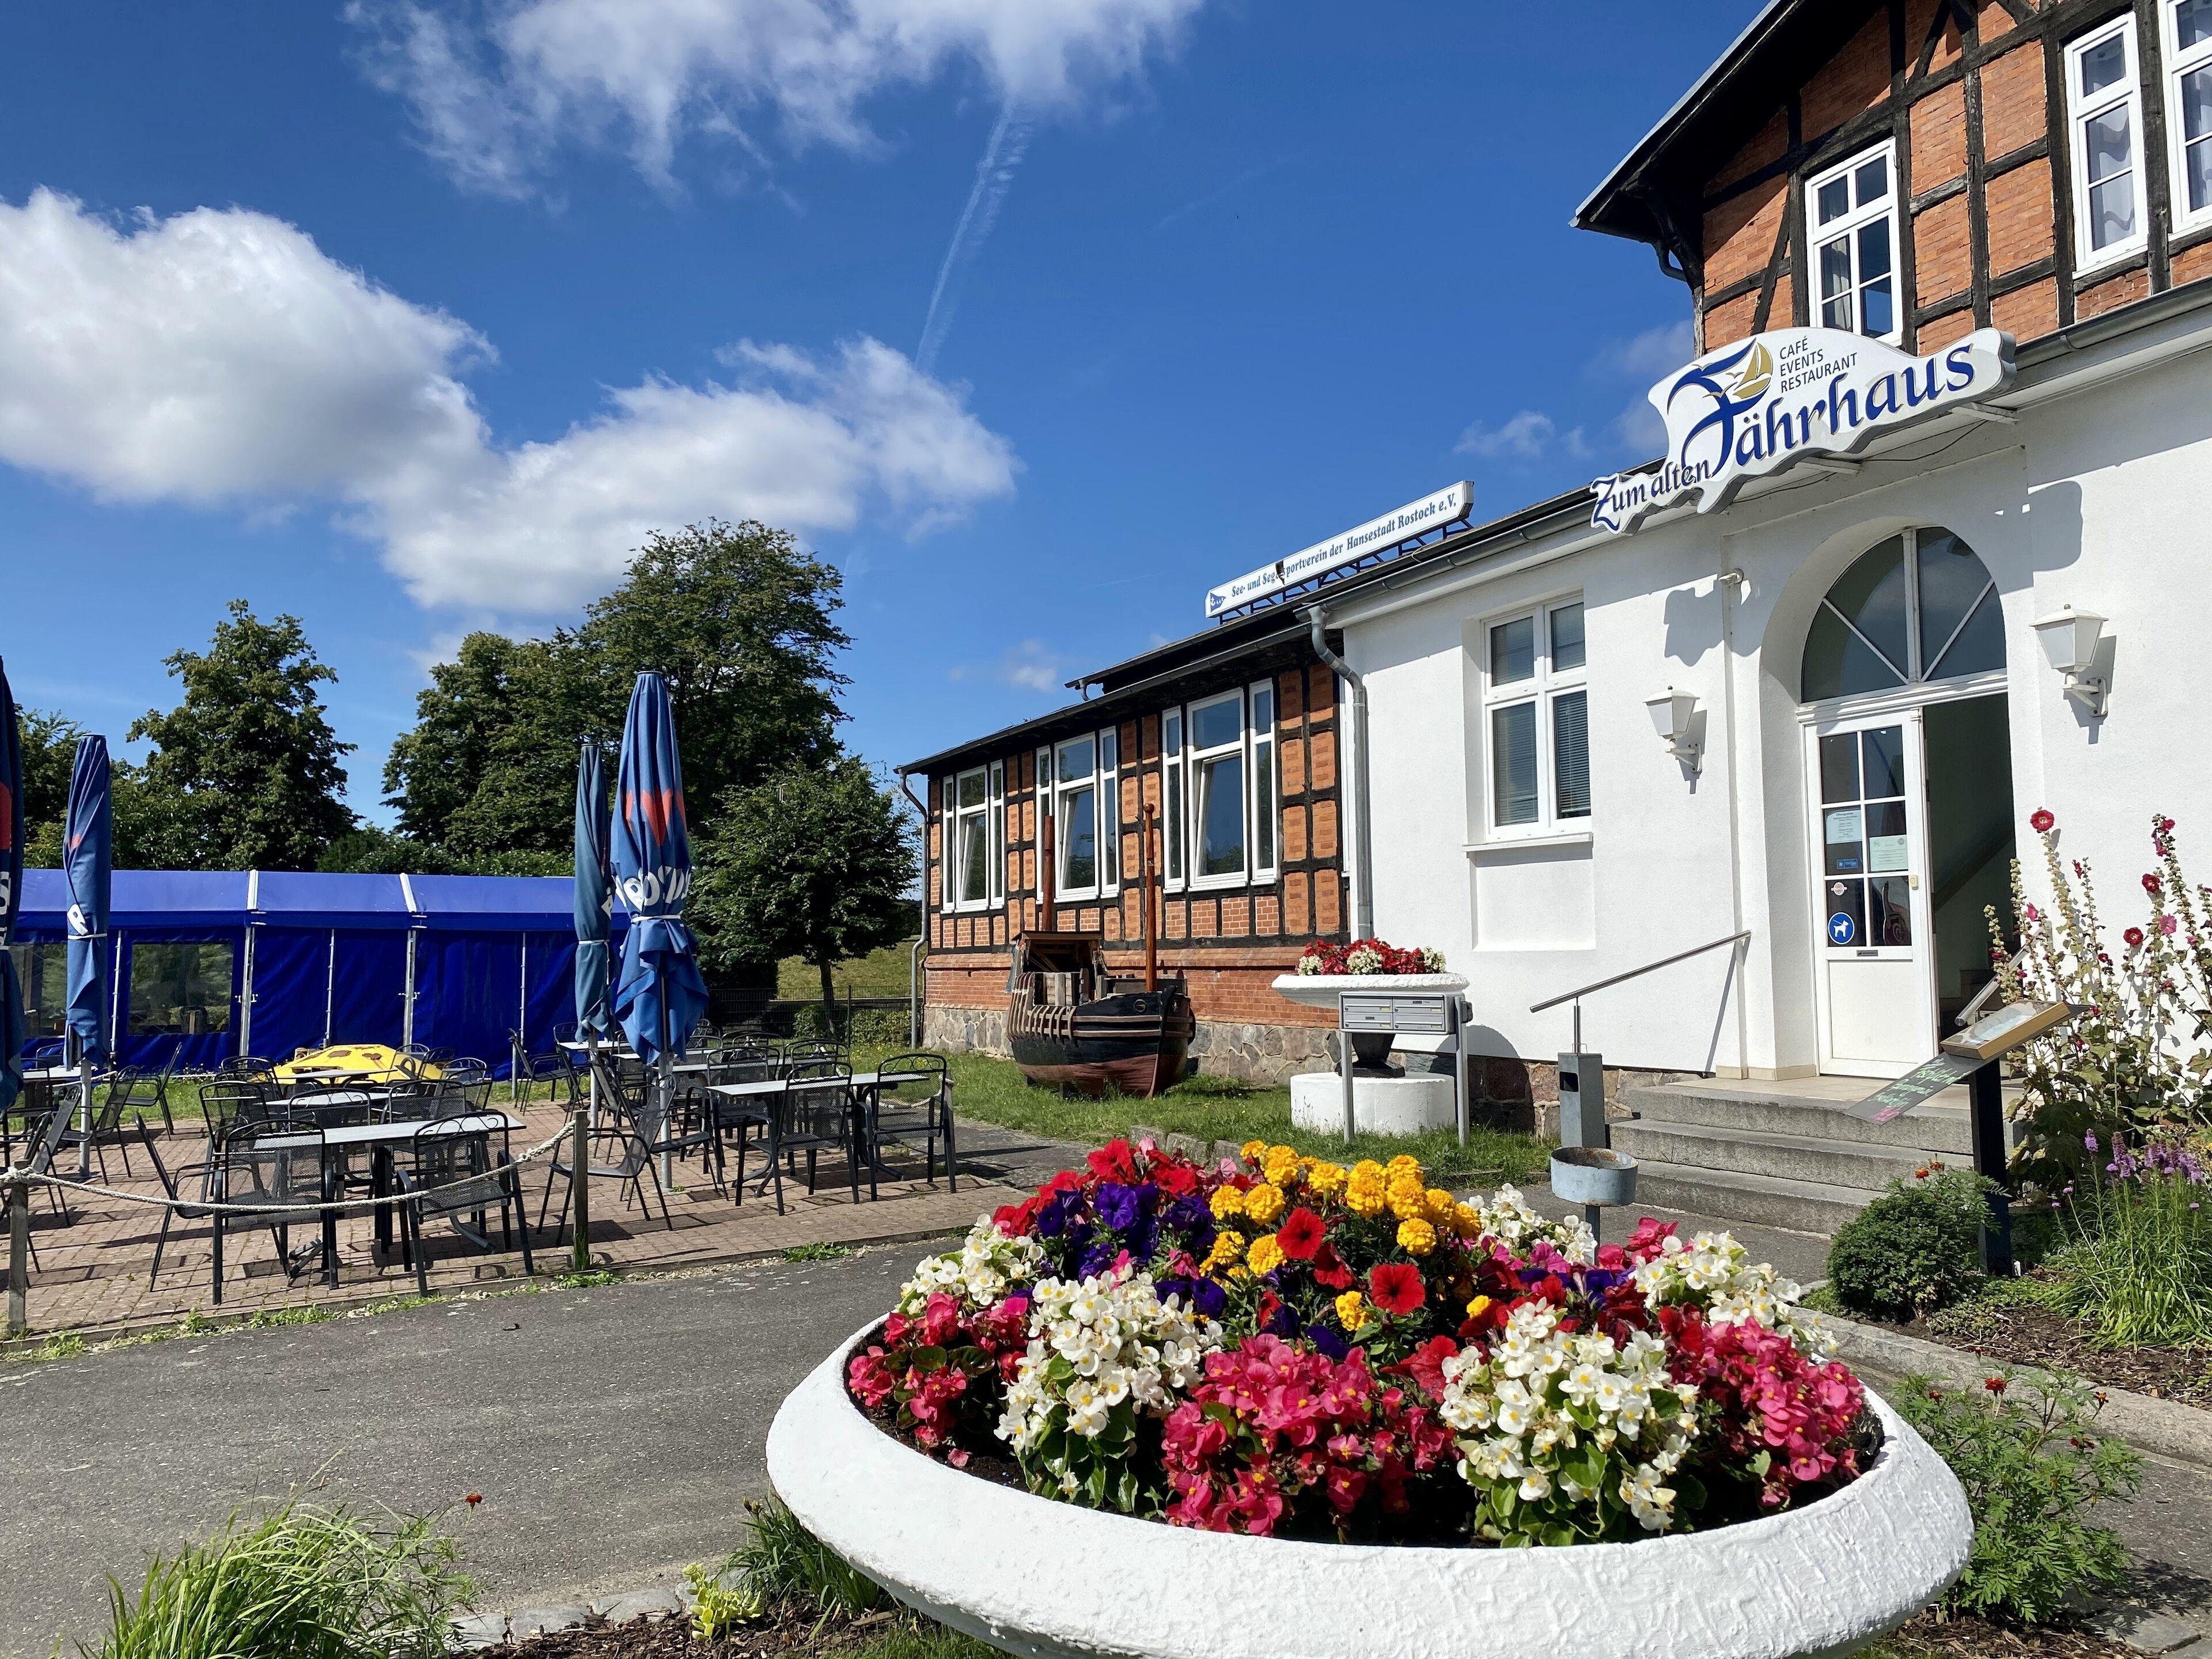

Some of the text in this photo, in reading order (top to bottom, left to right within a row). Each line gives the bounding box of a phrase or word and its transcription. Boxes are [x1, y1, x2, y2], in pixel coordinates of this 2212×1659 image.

[1779, 335, 1808, 359] CAFÉ
[1780, 349, 1824, 377] EVENTS
[1781, 352, 1857, 393] RESTAURANT
[1591, 336, 1975, 531] Zum alten Fährhaus
[1231, 493, 1456, 597] See- und Segsportverein der Hansestadt Rostock e.V.
